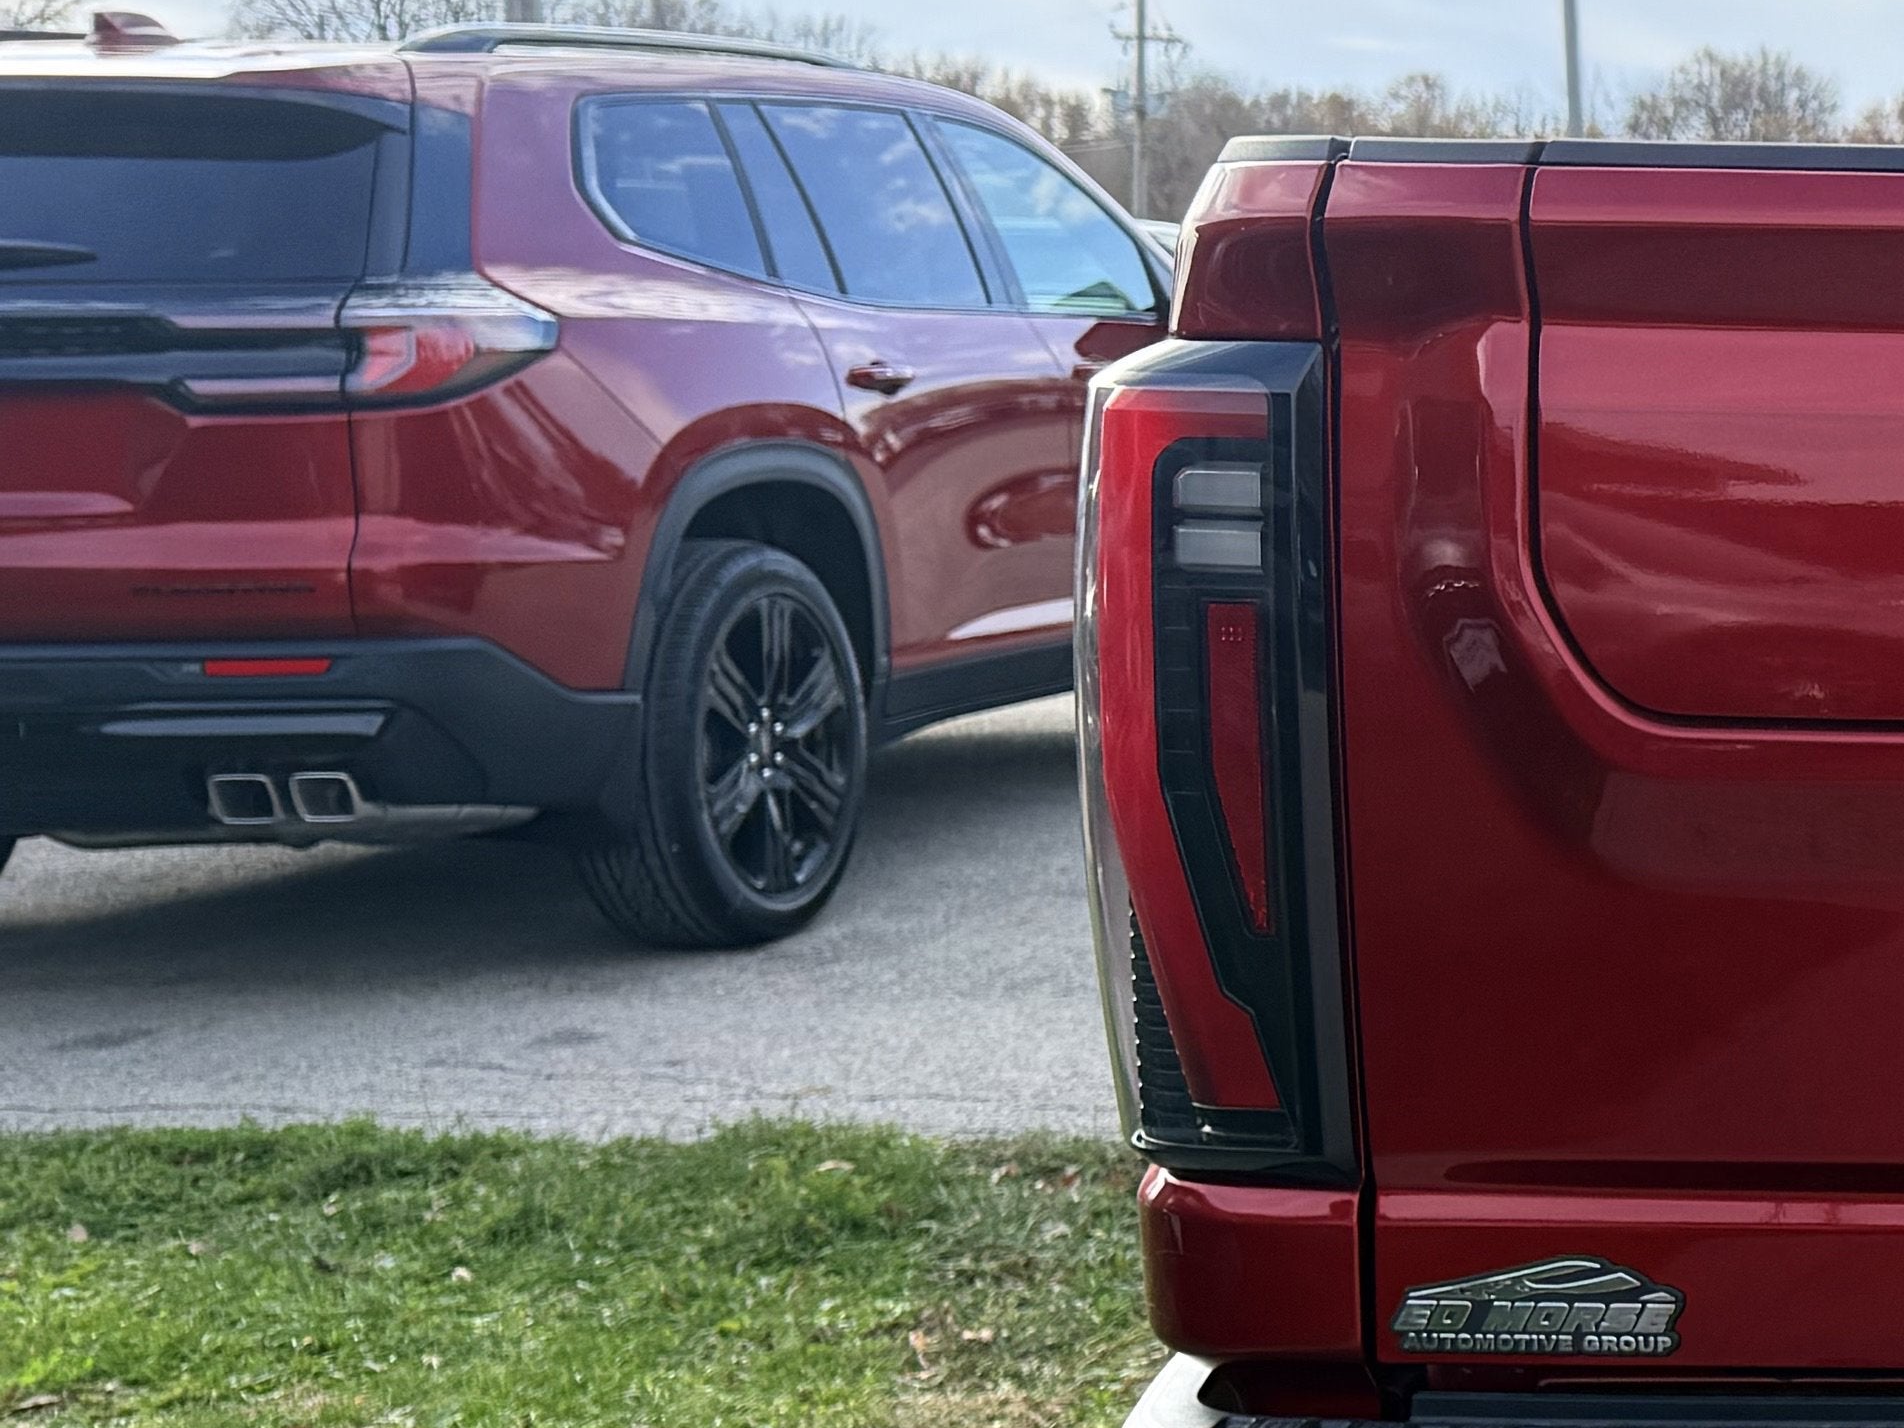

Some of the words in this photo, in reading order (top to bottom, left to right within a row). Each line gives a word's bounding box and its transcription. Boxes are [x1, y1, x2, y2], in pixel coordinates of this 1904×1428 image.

[1394, 1299, 1472, 1332] ED
[1480, 1300, 1677, 1334] MORSE
[1403, 1333, 1573, 1352] AUTOMOTIVE
[1583, 1335, 1673, 1354] GROUP
